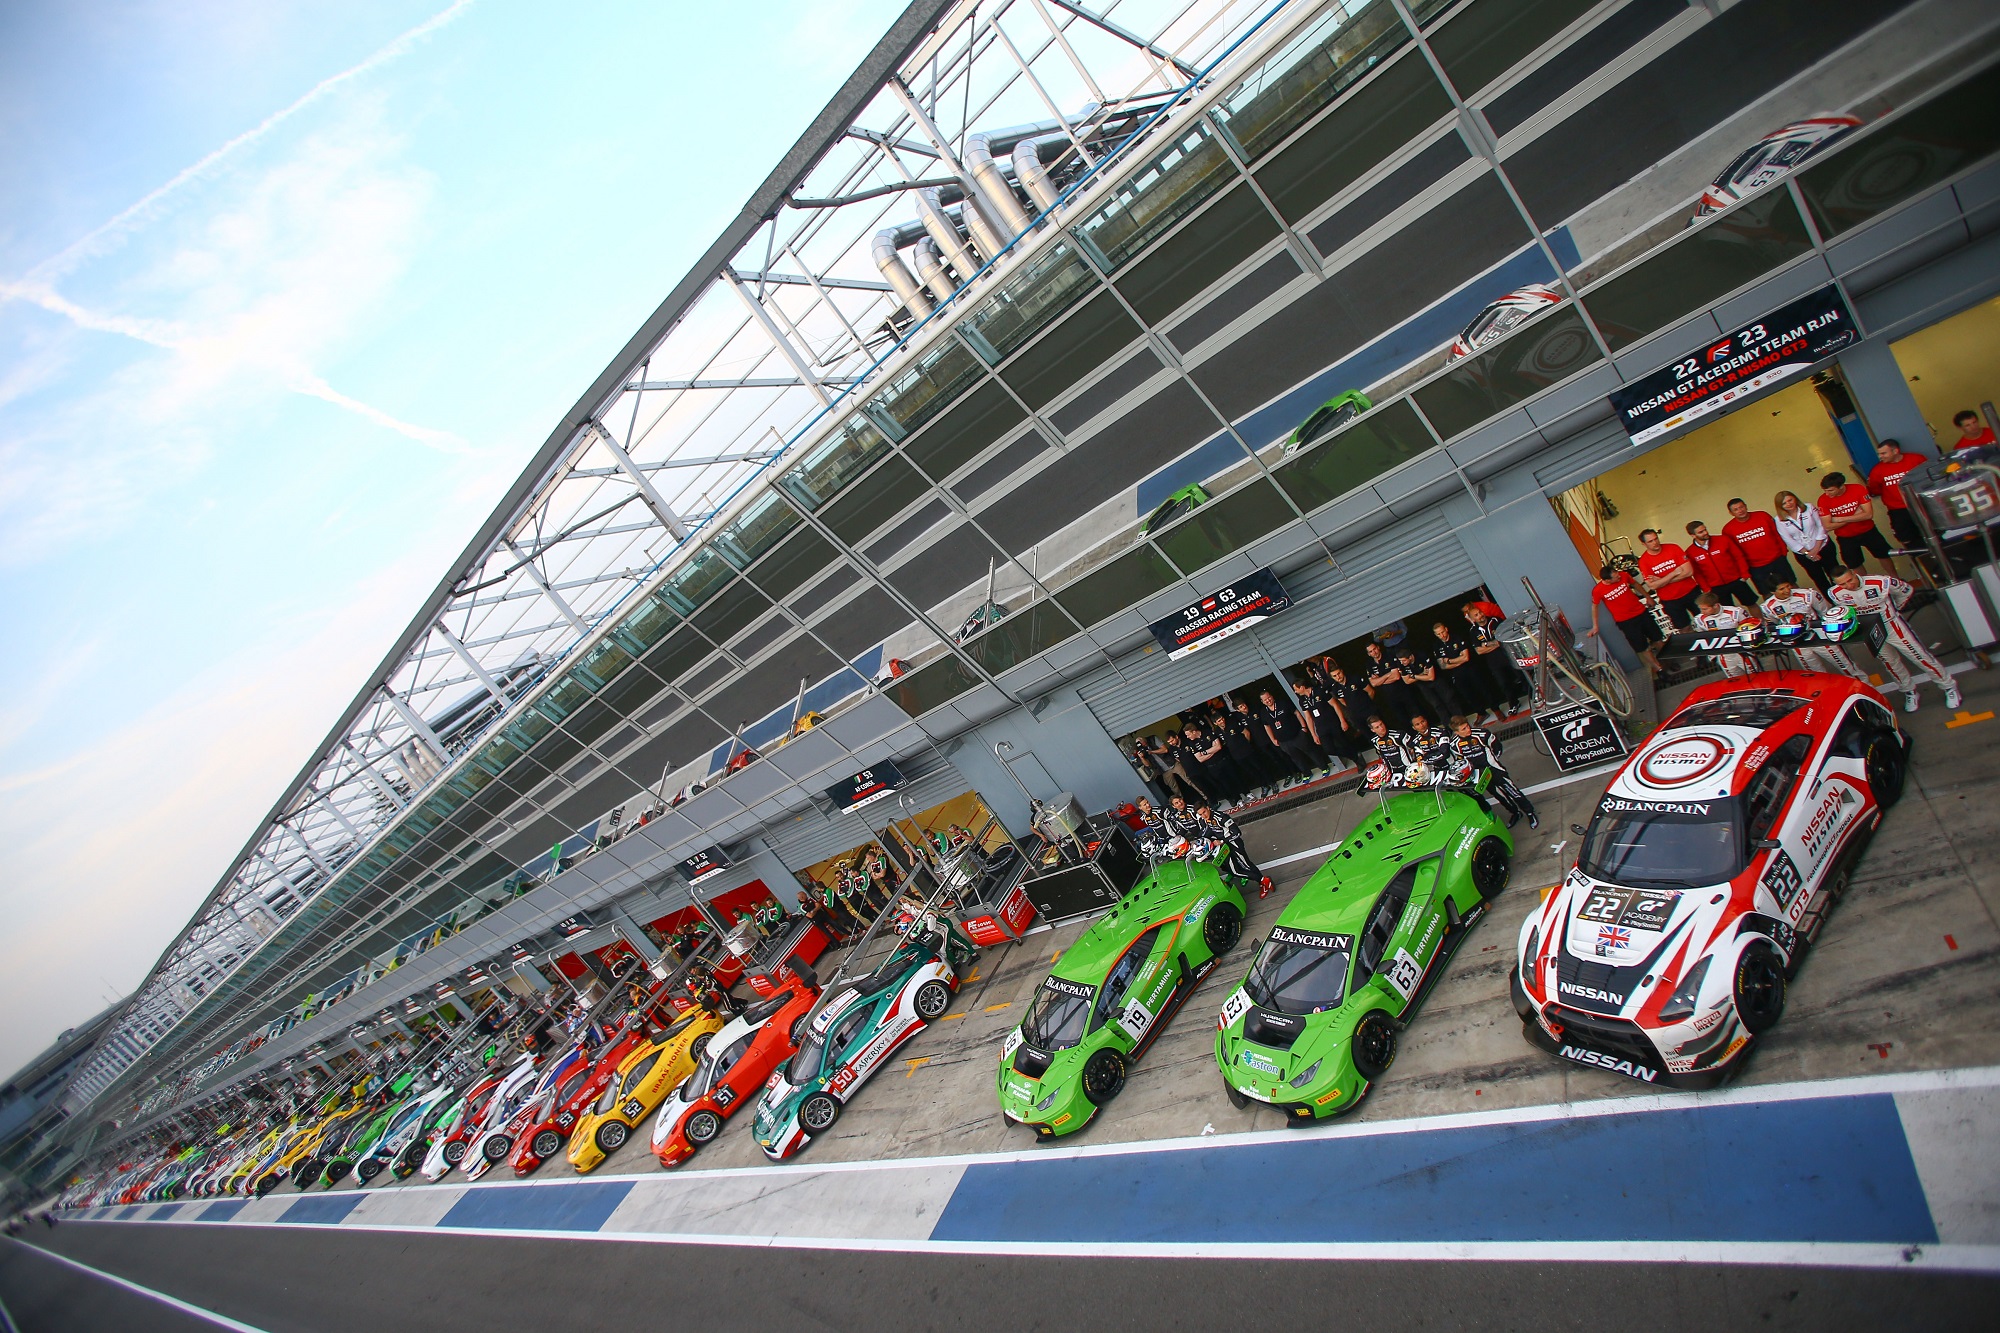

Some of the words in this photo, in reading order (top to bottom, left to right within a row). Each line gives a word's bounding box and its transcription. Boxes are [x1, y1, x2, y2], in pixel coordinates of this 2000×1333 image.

[1738, 325, 1768, 347] 23
[1627, 388, 1677, 418] NISSAN
[1677, 374, 1697, 395] GT
[1697, 348, 1761, 386] ACEDEMY
[1764, 326, 1806, 353] TEAM
[1807, 309, 1840, 332] RJN
[1672, 358, 1701, 380] 22
[1663, 386, 1709, 413] NISSAN
[1709, 372, 1738, 393] GT-R
[1739, 352, 1781, 377] NISMO
[1781, 339, 1808, 357] GT3
[1829, 501, 1858, 513] NISSAN
[1950, 486, 1993, 517] 35
[1735, 527, 1764, 539] NISSAN
[1652, 559, 1675, 571] NISSAN
[1218, 588, 1237, 603] 63
[1604, 583, 1626, 598] NISSAN
[1174, 616, 1209, 637] GRASSER
[1208, 603, 1238, 623] RACING
[1238, 591, 1262, 607] TEAM
[1176, 621, 1223, 645] LAMBORGHINI
[1256, 595, 1271, 608] GT3
[1183, 607, 1200, 621] 19
[1550, 707, 1590, 724] NISSAN
[1559, 733, 1611, 756] ACADEMY
[1575, 745, 1615, 762] PlayStation
[1652, 758, 1707, 766] nismo
[860, 780, 876, 791] CORSE
[863, 770, 874, 780] 53
[1614, 800, 1711, 816] BLANCPAIN
[1801, 786, 1840, 846] NISSAN
[1808, 798, 1841, 858] nismo
[1464, 828, 1480, 850] RACING
[1766, 854, 1788, 886] BLANCPAIN
[1592, 889, 1631, 898] BLANCPAIN
[1773, 864, 1798, 904] 22
[1640, 891, 1672, 901] NISSAN
[1789, 888, 1810, 921] GT3
[1585, 896, 1620, 919] 22
[1625, 911, 1668, 923] ACADEMY
[1271, 928, 1350, 949] BLANCPAIN
[1413, 912, 1441, 960] PERTAMINA
[1396, 960, 1417, 991] 63
[1045, 976, 1094, 998] BLANCPAIN
[1146, 968, 1173, 1008] PERTAMINA
[1560, 981, 1623, 1005] NISSAN
[1226, 995, 1243, 1020] 63
[1127, 1010, 1147, 1031] 19
[1696, 1013, 1721, 1029] MOTUL
[652, 1069, 669, 1094] BRAAS
[667, 1037, 688, 1068] MONIER
[854, 1040, 886, 1073] KASPERSKY
[1560, 1045, 1658, 1082] NISSAN
[834, 1069, 852, 1089] 50
[718, 1089, 733, 1105] 51
[1317, 1091, 1340, 1105] PIRELLI
[559, 1111, 574, 1128] 53
[626, 1102, 642, 1118] 52
[1054, 1114, 1070, 1125] PIRELLI
